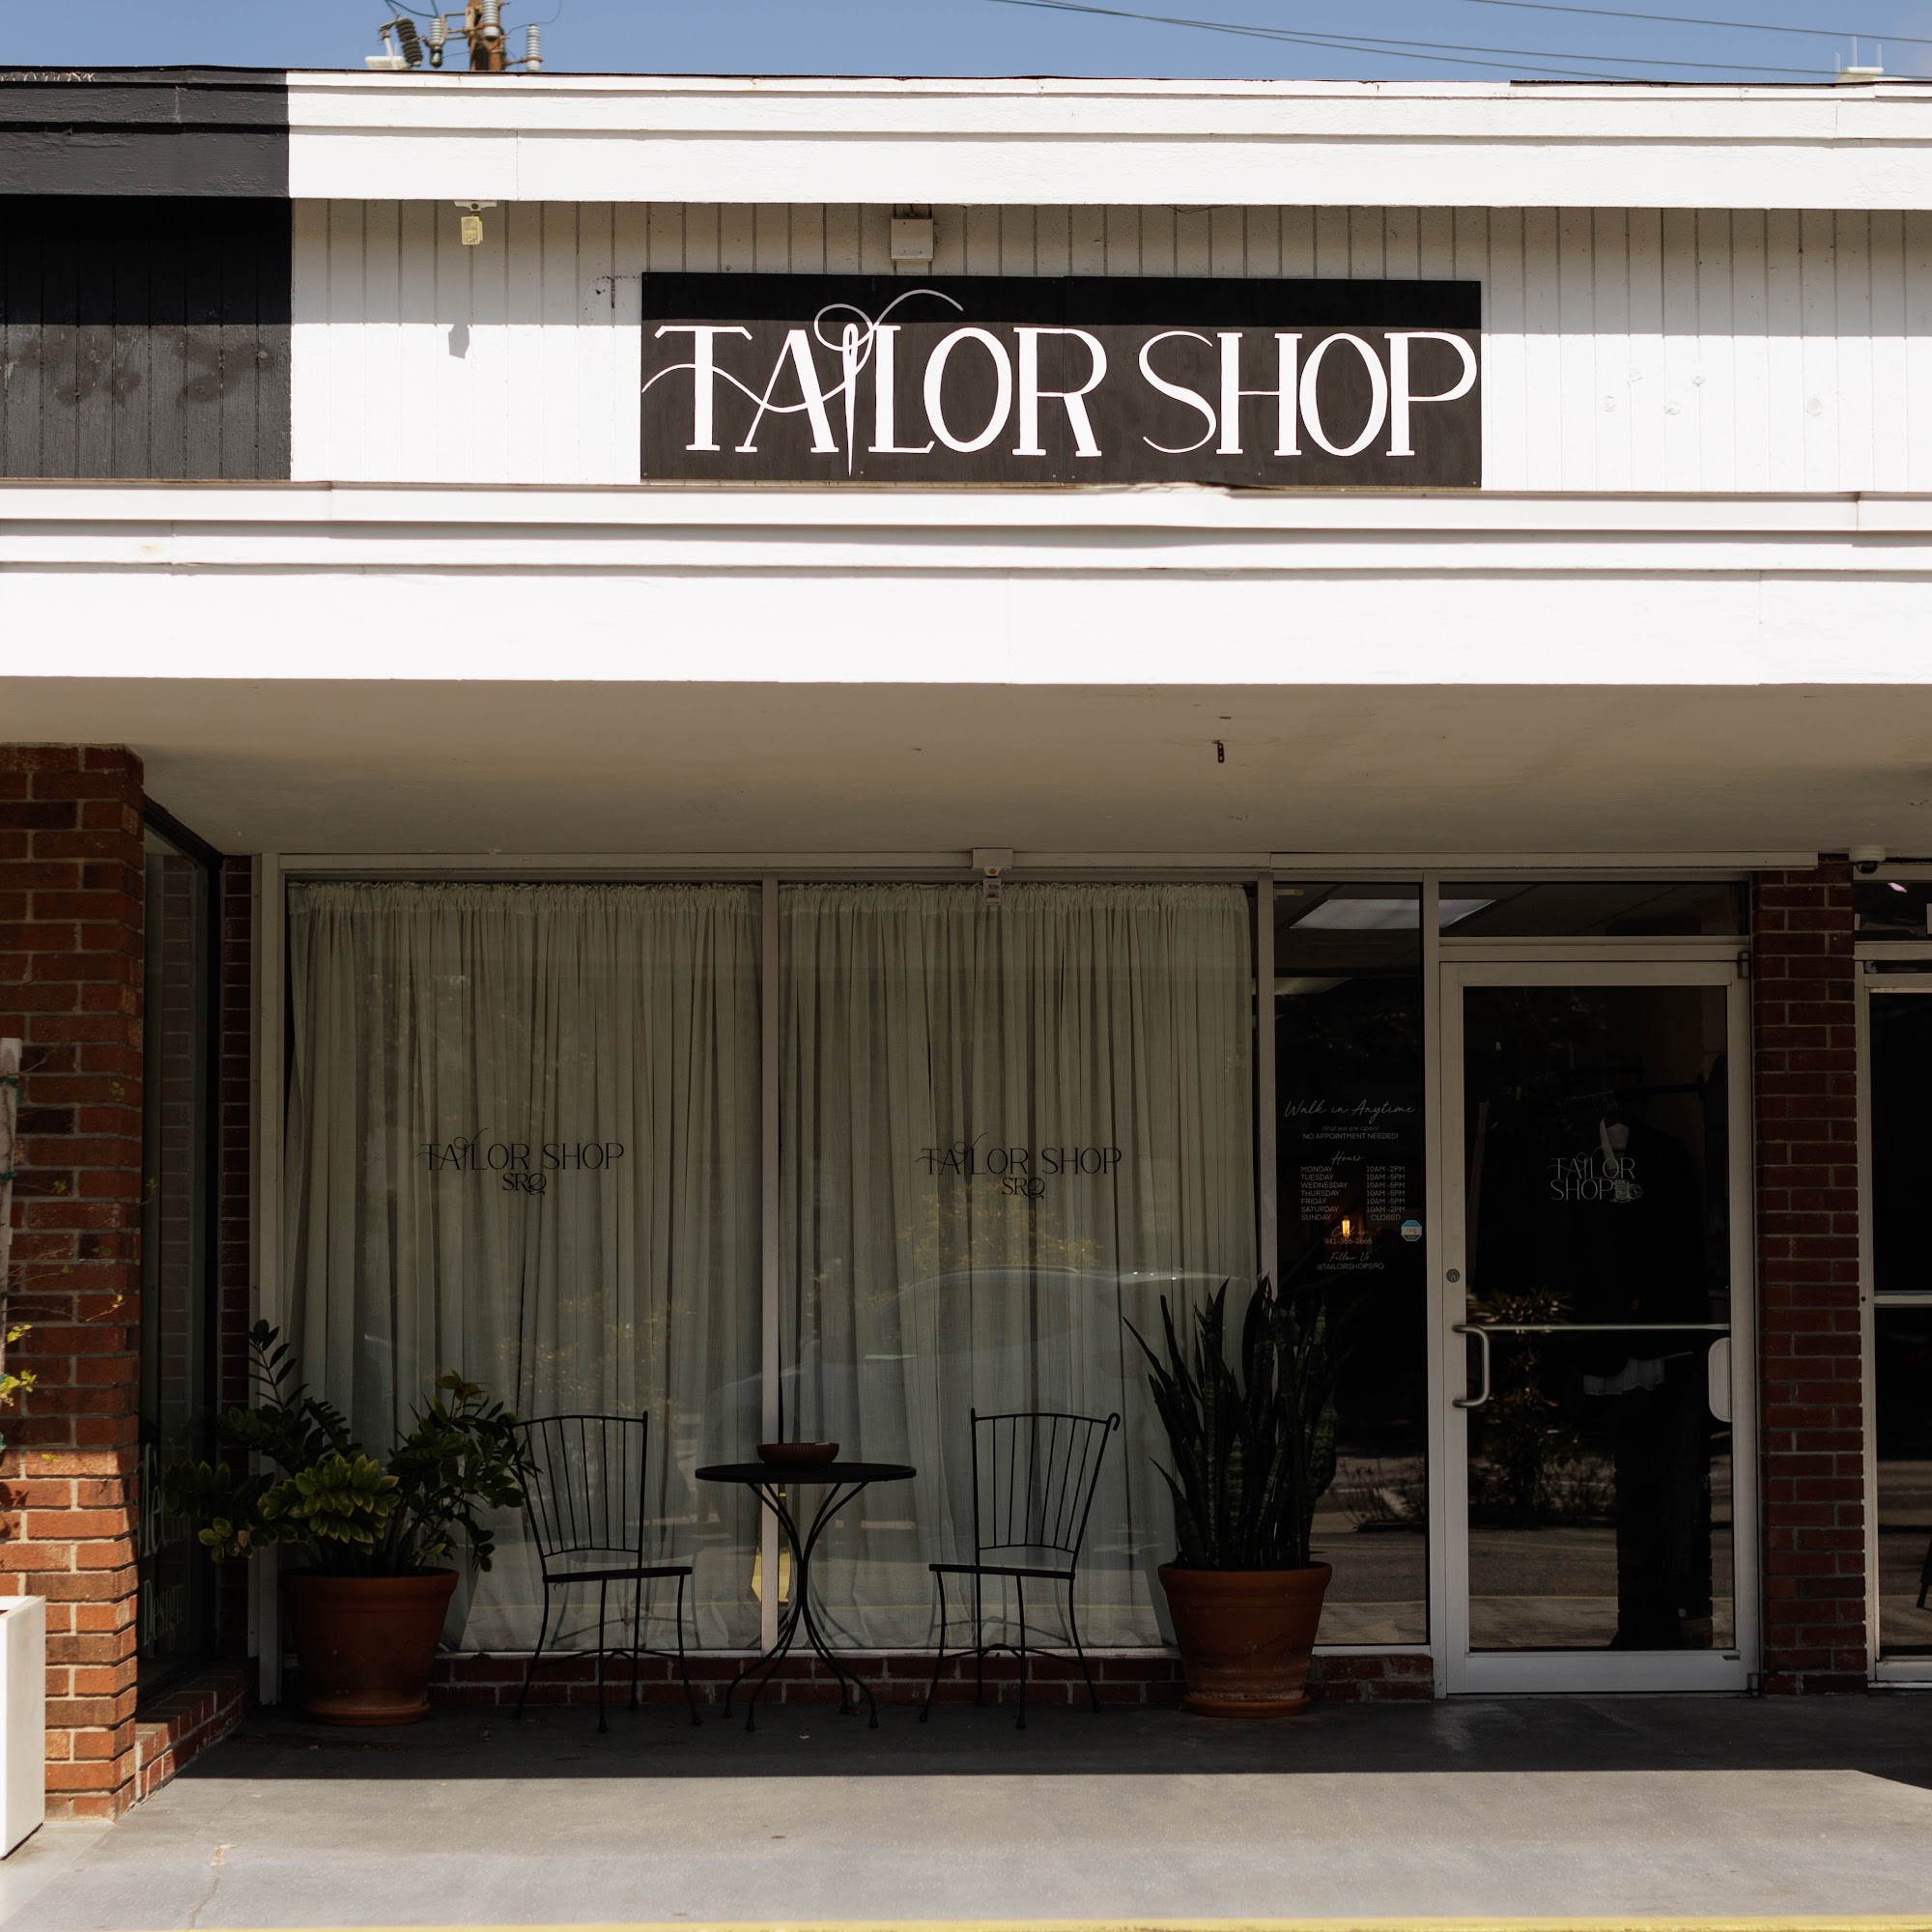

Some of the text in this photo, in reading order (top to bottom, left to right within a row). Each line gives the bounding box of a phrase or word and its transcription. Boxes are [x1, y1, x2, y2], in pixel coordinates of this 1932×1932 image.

[641, 295, 1478, 470] TAILOR SHOP
[1284, 1098, 1416, 1124] Walk in Anytime
[416, 1134, 625, 1173] TAILOR SHOP
[916, 1139, 1122, 1177] TAILOR SHOP
[1331, 1150, 1365, 1165] Hours
[1547, 1151, 1635, 1179] TAILOR
[502, 1172, 547, 1196] SRQ
[1002, 1177, 1045, 1200] SRQ
[1550, 1179, 1614, 1201] SHOP
[1316, 1263, 1384, 1271] @TAILORSHOPSRQ
[1329, 1251, 1371, 1263] Follow Us
